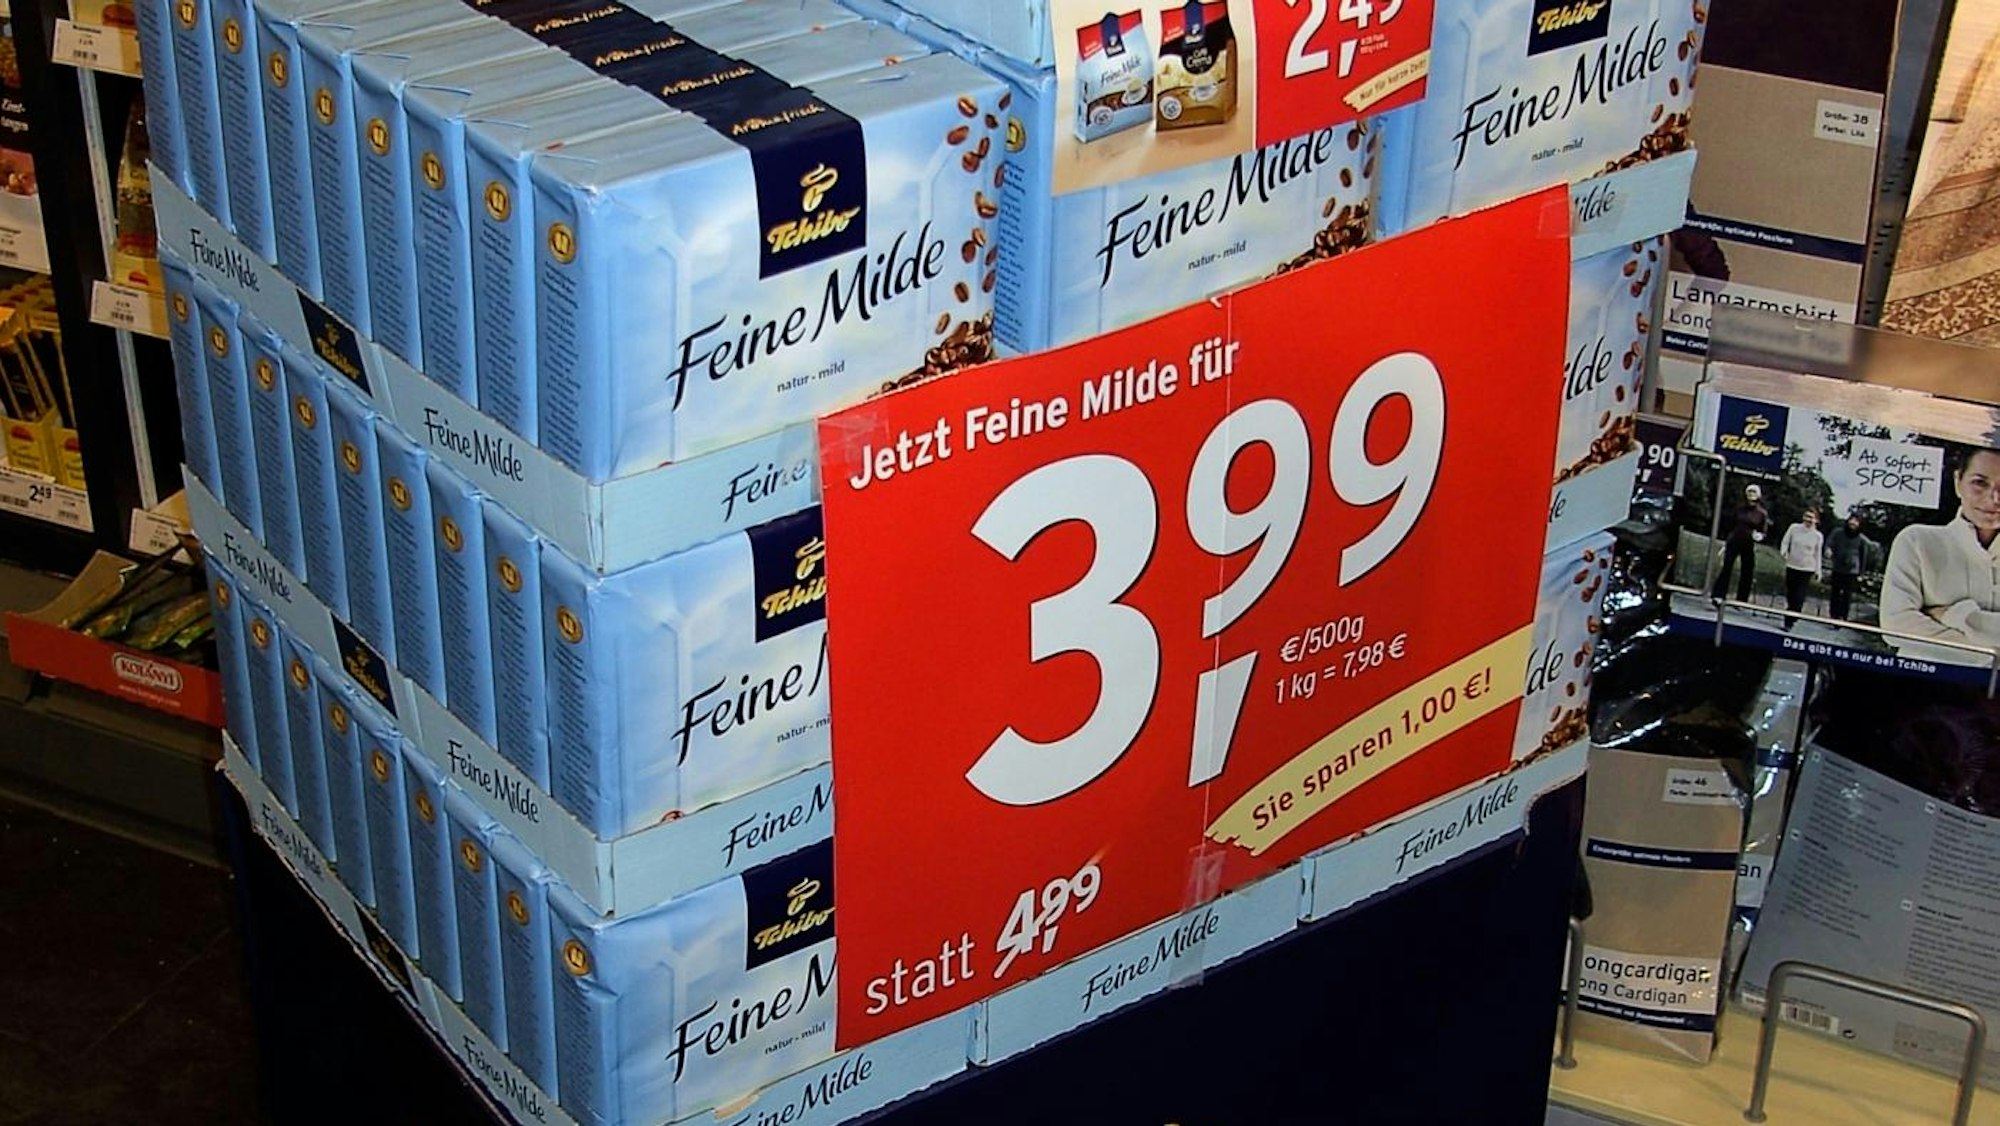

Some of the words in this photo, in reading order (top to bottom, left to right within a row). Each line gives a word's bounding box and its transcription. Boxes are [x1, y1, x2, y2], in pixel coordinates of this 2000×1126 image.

[1537, 1, 1608, 36] Tchibo
[1452, 82, 1560, 171] Feine
[1561, 18, 1668, 120] Milde
[1852, 113, 1869, 125] 38
[766, 205, 861, 255] Tchibo
[1096, 183, 1215, 290] Feine
[1219, 126, 1334, 222] Milde
[1573, 180, 1616, 225] ilde
[189, 228, 226, 274] Feine
[666, 303, 807, 412] Feine
[810, 220, 946, 343] Milde
[848, 417, 952, 491] Jetzt
[964, 394, 1068, 452] Feine
[1081, 357, 1178, 417] Milde
[1188, 338, 1240, 387] für
[423, 407, 472, 459] Feine
[473, 429, 524, 482] Milde
[1719, 433, 1780, 456] Tchibo
[1858, 448, 1879, 464] Ab
[1855, 467, 1935, 495] SPORT
[761, 575, 828, 619] Tchib
[965, 351, 1446, 806] 3,99
[1279, 614, 1365, 666] €/500g
[1783, 637, 1806, 651] Das
[1808, 643, 1832, 657] gibt
[1834, 649, 1849, 659] es
[1852, 652, 1873, 664] nur
[1875, 655, 1894, 667] bei
[1897, 658, 1937, 674] Tchibo
[1275, 679, 1286, 704] 1
[1289, 670, 1317, 701] kg
[670, 664, 803, 767] Feine
[447, 738, 493, 793] Feine
[494, 768, 540, 824] Milde
[1250, 788, 1295, 831] Sie
[1301, 726, 1394, 799] sparen
[1399, 687, 1457, 737] 1,00
[721, 804, 804, 868] Feine
[1396, 820, 1458, 874] Feine
[1457, 778, 1519, 836] Milde
[753, 905, 834, 950] Tchibo
[865, 931, 975, 1016] statt
[996, 863, 1102, 978] 4,99
[1081, 956, 1152, 1015] Feine
[1150, 908, 1220, 973] Milde
[1584, 956, 1710, 985] ongcardigan
[1579, 978, 1608, 996] ong
[1613, 983, 1688, 1007] Cardigan
[665, 987, 792, 1084] Feine
[503, 1070, 547, 1125] Milde
[796, 1052, 873, 1121] Milde
